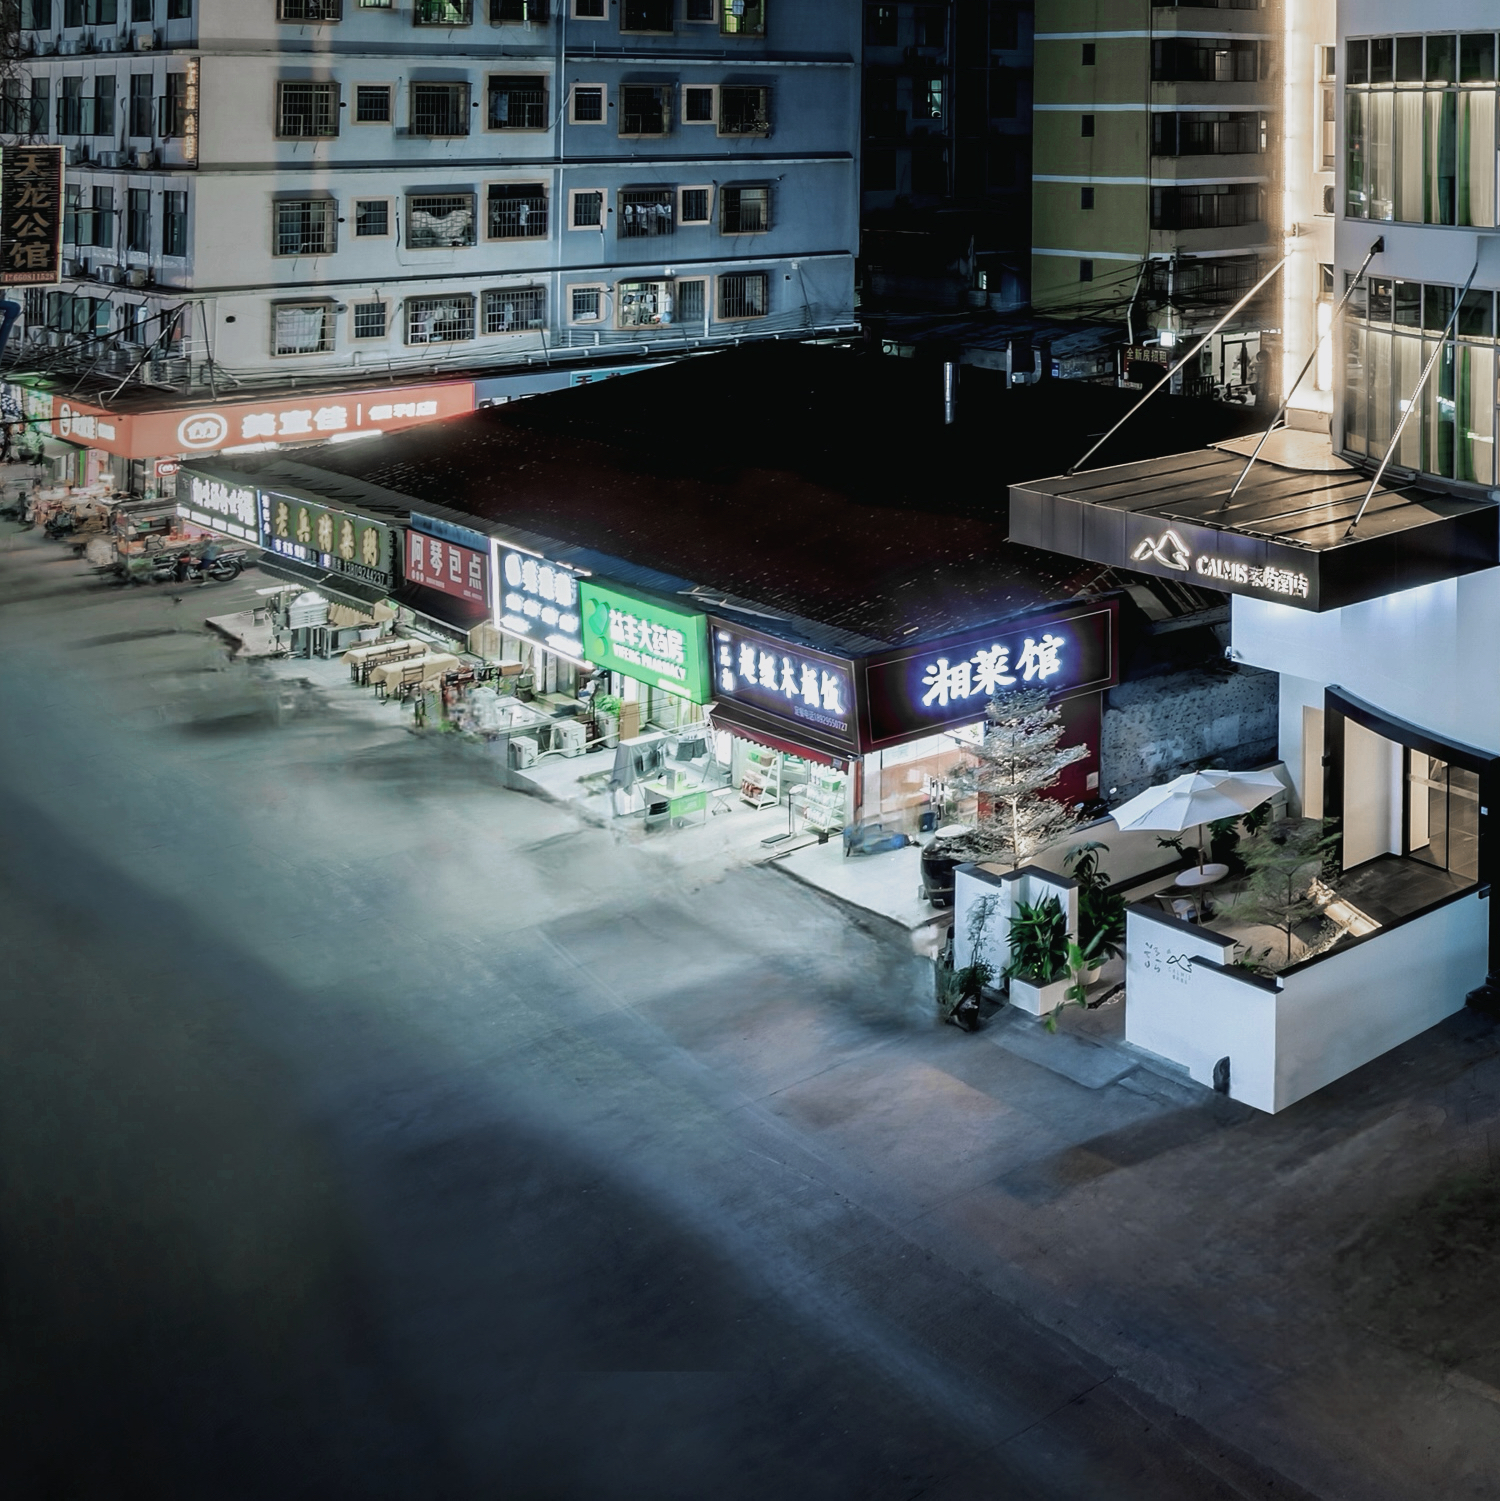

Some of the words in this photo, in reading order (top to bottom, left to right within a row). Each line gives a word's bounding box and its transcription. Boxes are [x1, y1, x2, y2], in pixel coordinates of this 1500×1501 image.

[8, 153, 52, 269] 天龙公馆
[1126, 347, 1168, 363] 全新房招租
[411, 533, 482, 591] 阿琴包点
[1196, 555, 1248, 583] CALMIS
[609, 608, 685, 664] 益丰大药房
[921, 633, 1065, 707] 湘菜馆
